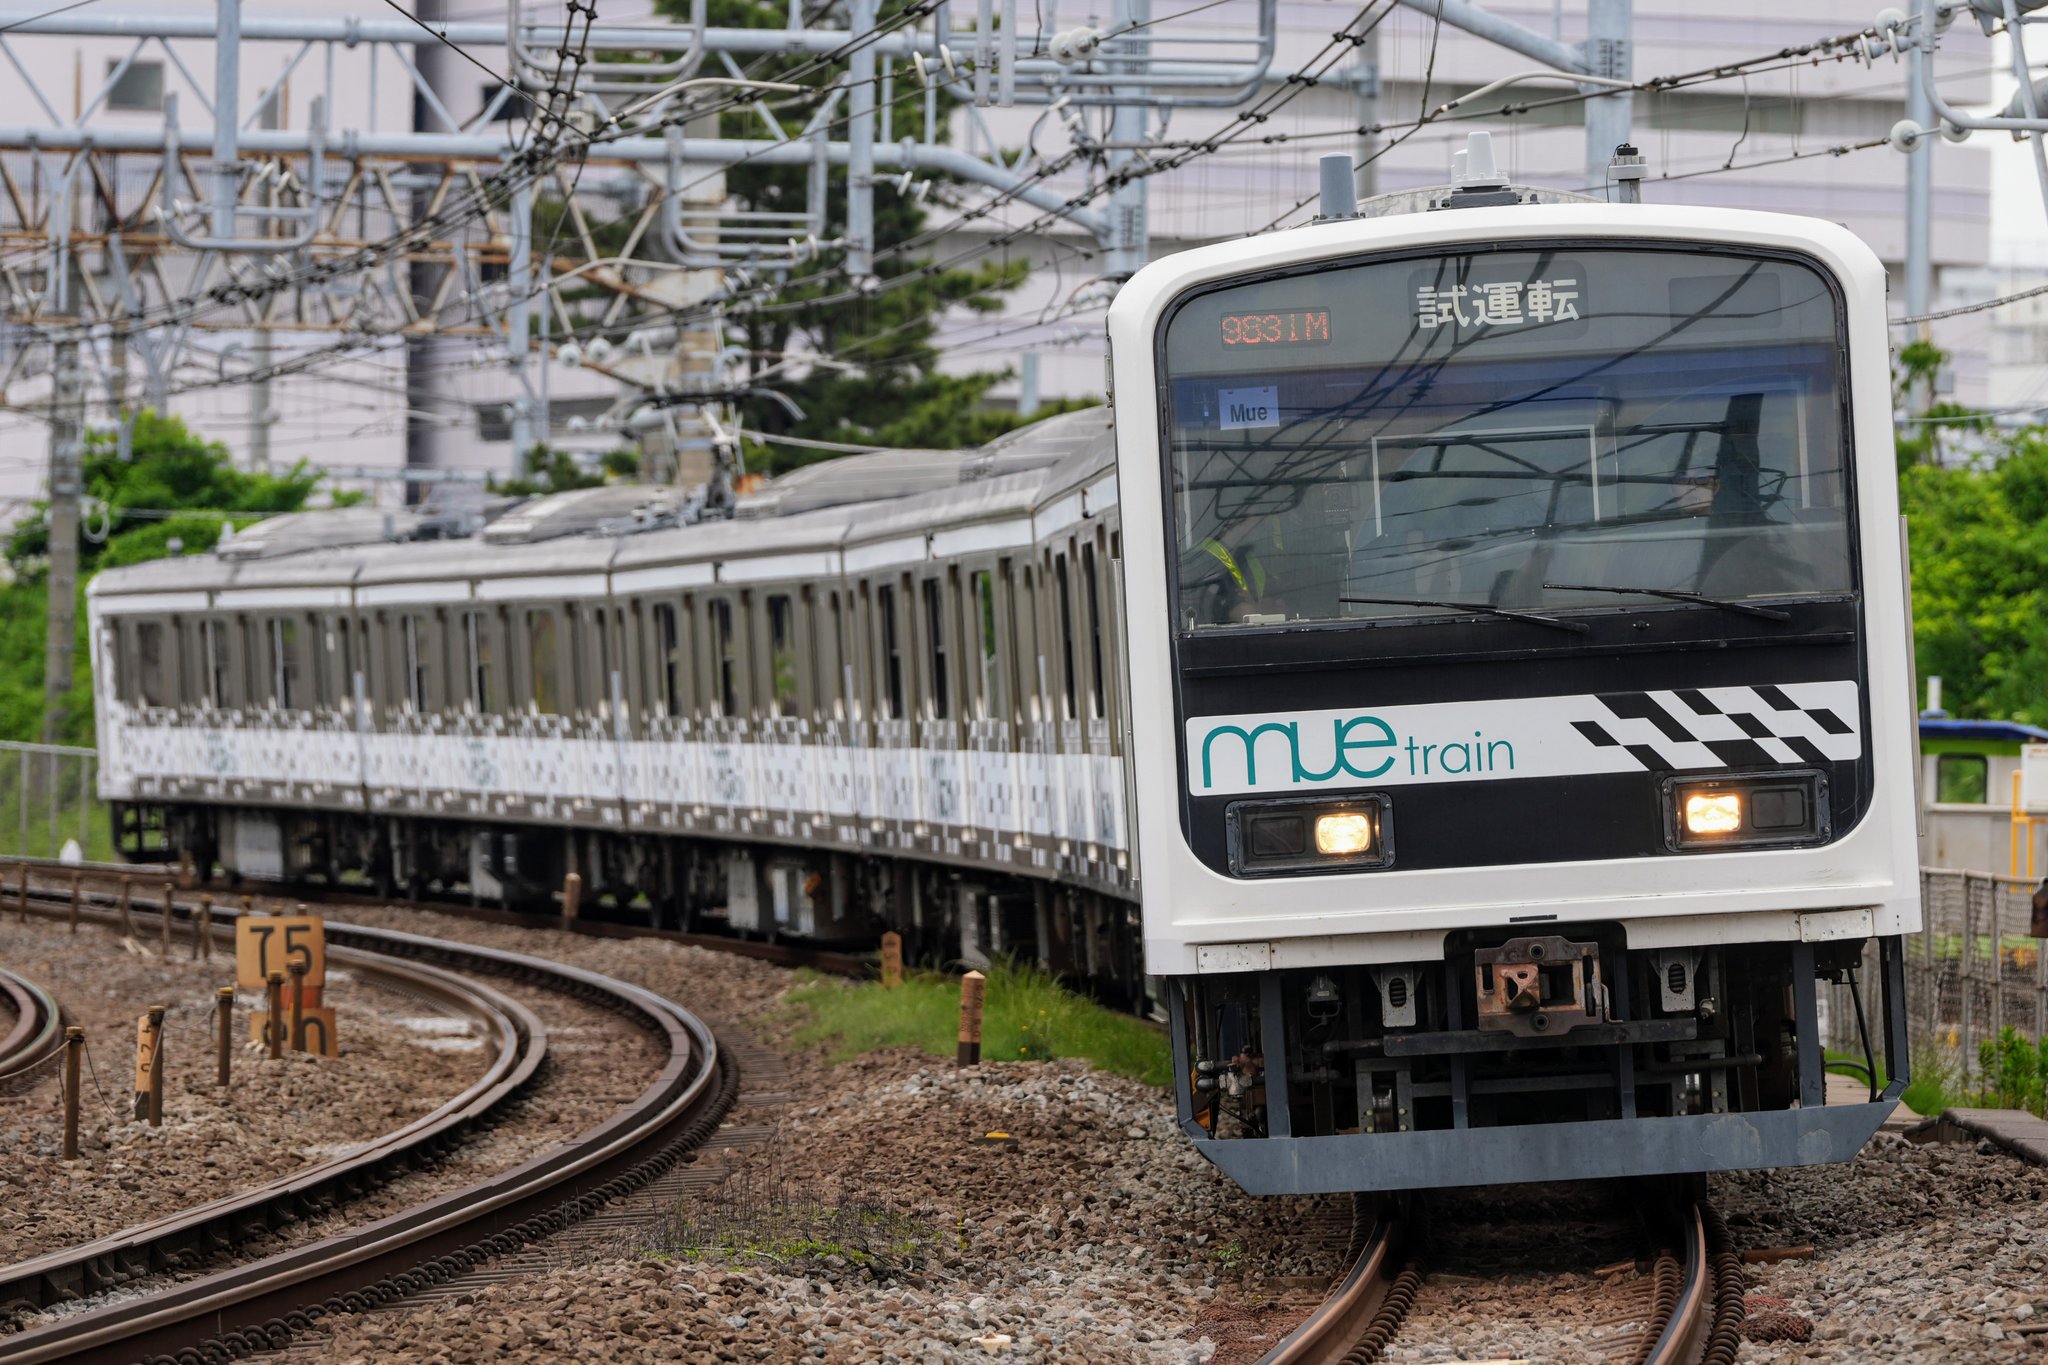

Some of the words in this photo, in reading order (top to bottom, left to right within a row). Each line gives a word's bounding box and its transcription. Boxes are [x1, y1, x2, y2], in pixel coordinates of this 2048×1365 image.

[1222, 312, 1328, 344] 9831M
[1416, 280, 1579, 328] 試運転
[1230, 403, 1268, 422] Mue
[1202, 716, 1397, 788] mue
[1404, 731, 1514, 776] train
[249, 925, 312, 977] 75
